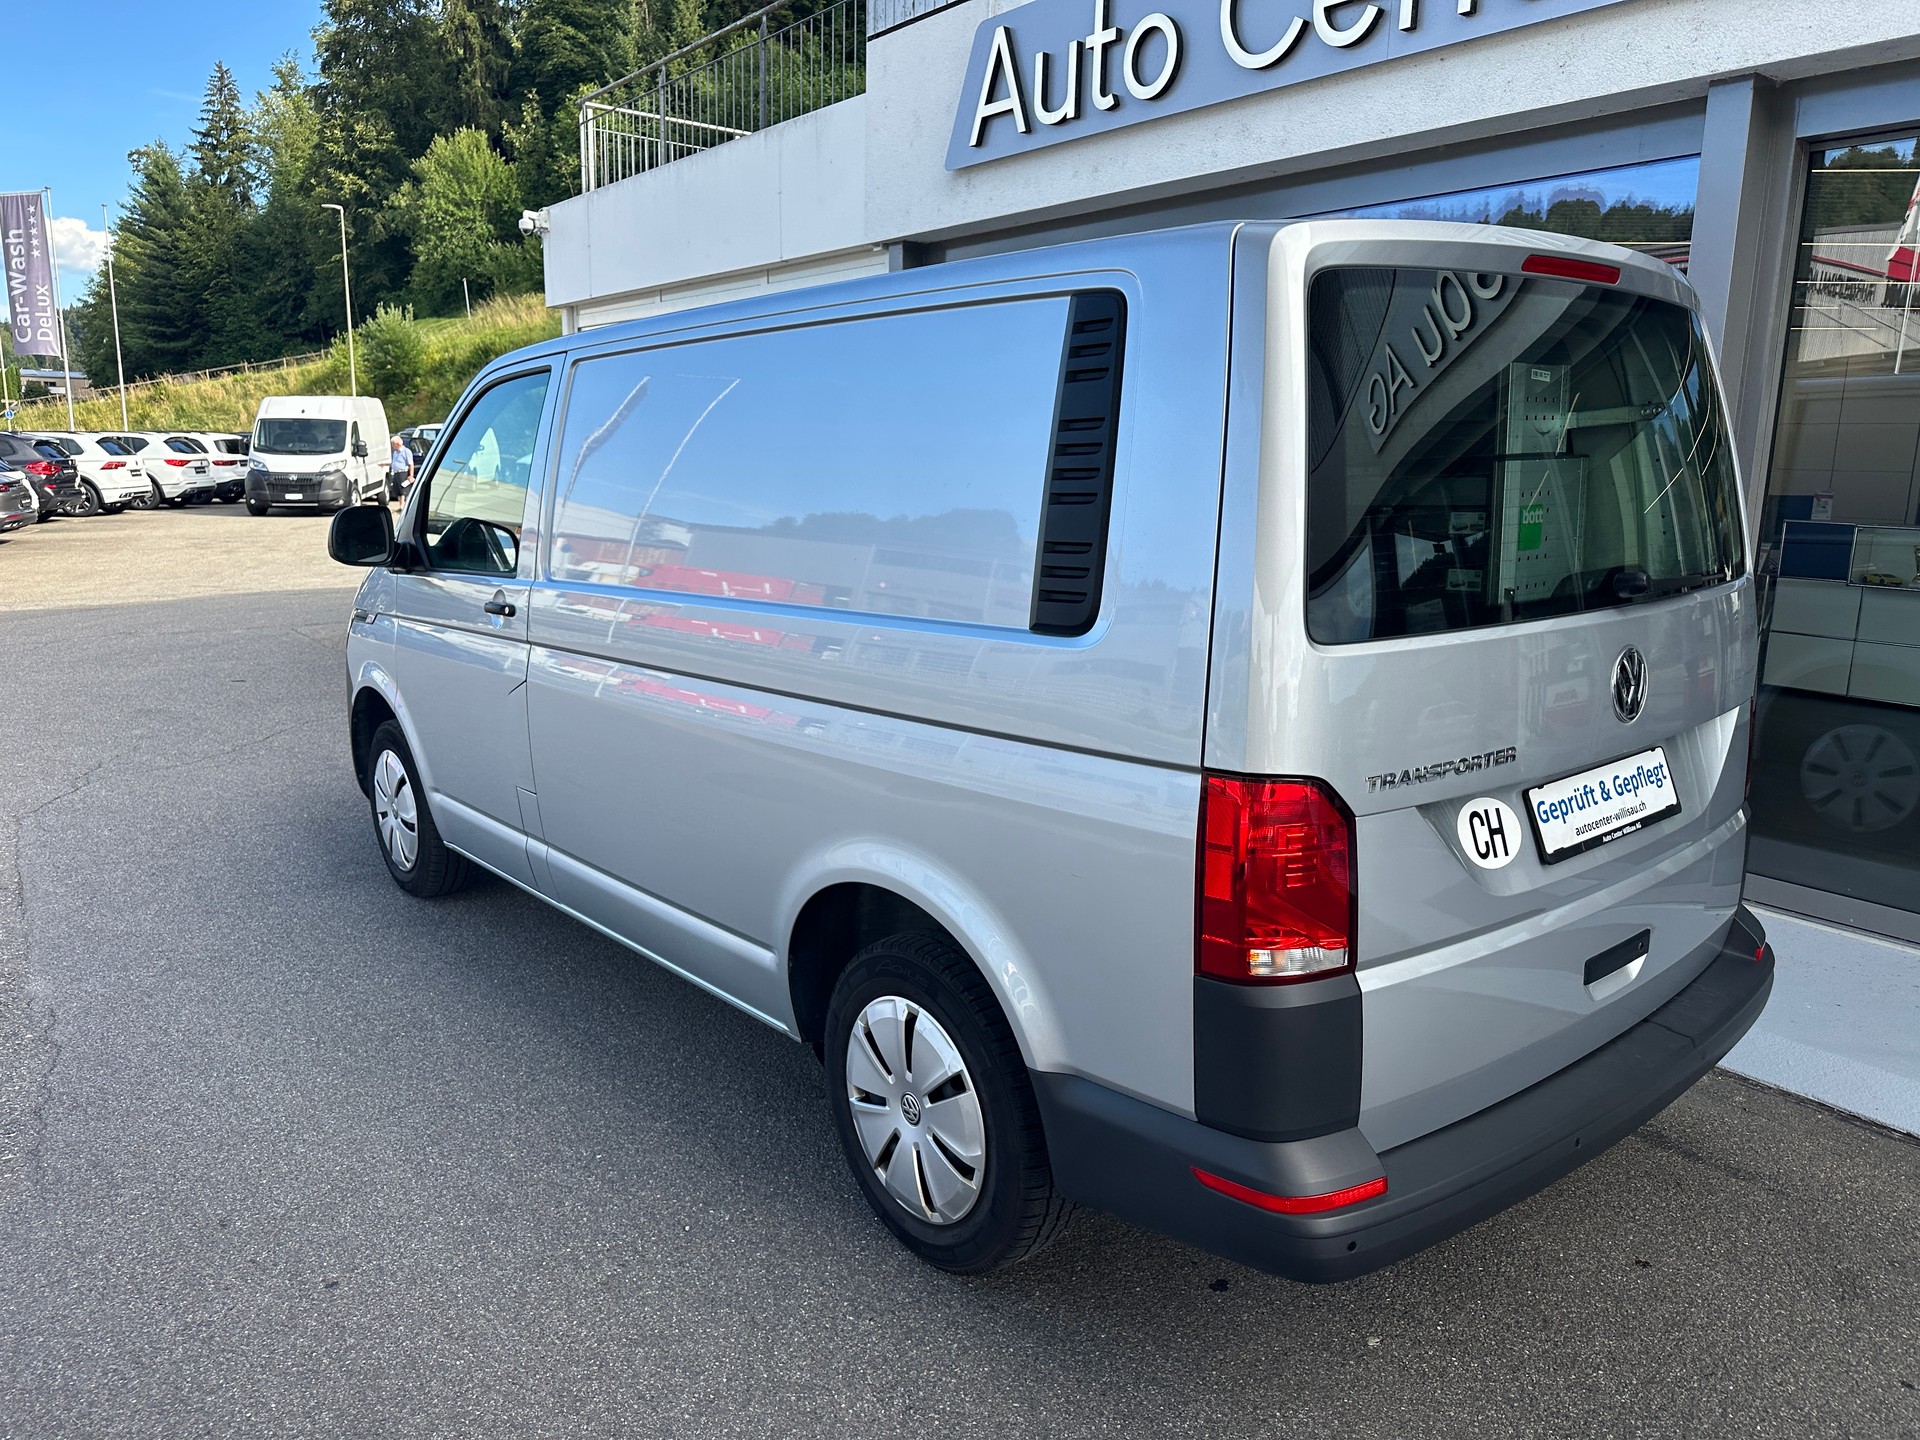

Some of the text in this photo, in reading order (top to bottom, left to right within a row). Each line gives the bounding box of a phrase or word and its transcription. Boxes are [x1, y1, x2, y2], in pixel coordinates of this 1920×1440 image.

[969, 0, 1182, 147] Auto
[5, 228, 31, 343] Car-Wash
[1522, 508, 1544, 524] bott
[1365, 746, 1517, 793] TRANSPORTER
[1536, 761, 1667, 825] Geprüft & Gepflegt
[1468, 807, 1509, 860] CH
[1575, 800, 1647, 836] autocenter-willisau.ch
